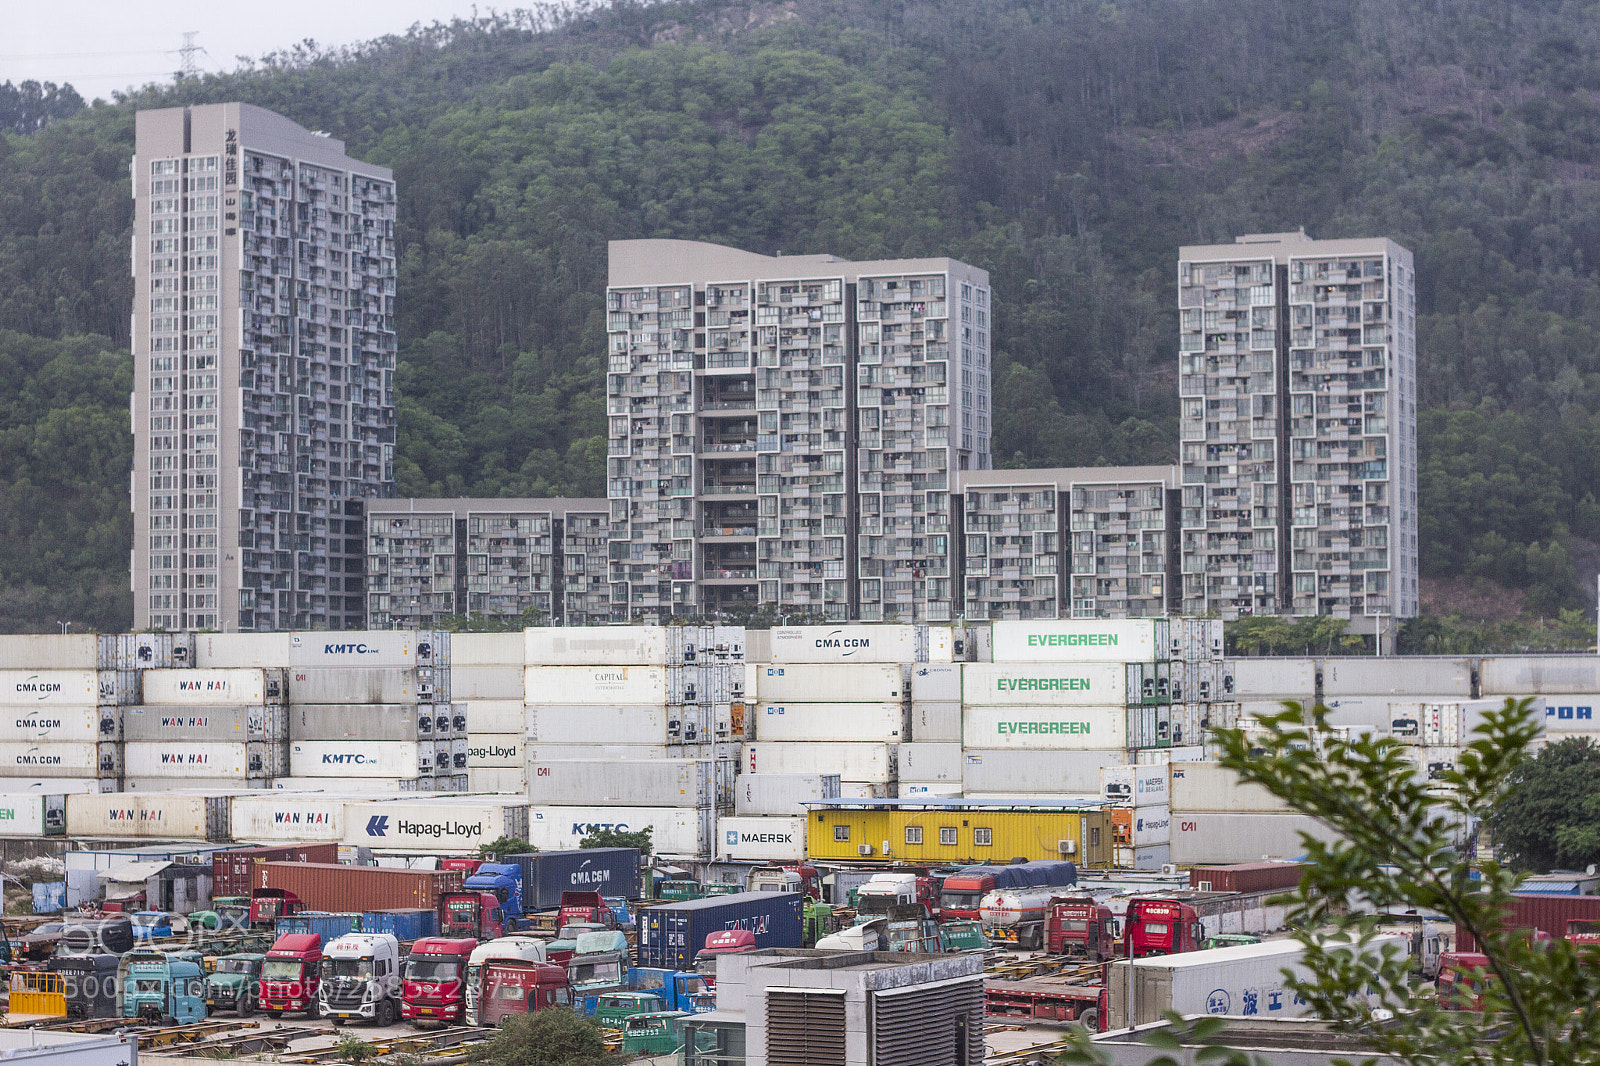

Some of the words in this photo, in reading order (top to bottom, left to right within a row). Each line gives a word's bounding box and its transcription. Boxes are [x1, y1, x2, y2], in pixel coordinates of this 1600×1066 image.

[815, 639, 841, 648] CMA
[843, 638, 870, 648] CGM
[1028, 634, 1119, 647] EVERGREEN
[324, 643, 368, 654] KMTC
[295, 674, 306, 682] CAI
[16, 683, 38, 692] CMA
[39, 683, 61, 692] CGM
[180, 681, 201, 690] WAN
[207, 681, 226, 690] HAI
[997, 678, 1091, 691] EVERGREEN
[16, 719, 38, 728] CMA
[39, 719, 61, 728] CGM
[161, 717, 183, 727] WAN
[188, 717, 208, 727] HAI
[997, 722, 1091, 734] EVERGREEN
[467, 745, 516, 759] pag-Lloyd
[16, 755, 38, 765] CMA
[39, 755, 61, 765] CGM
[161, 753, 184, 764] WAN
[188, 753, 208, 764] HAI
[322, 754, 366, 764] KMTC
[537, 767, 550, 776] CAI
[109, 809, 134, 820] WAN
[140, 809, 162, 820] HAI
[275, 812, 300, 824] WAN
[306, 812, 328, 824] HAI
[398, 820, 482, 838] Hapag-Lloyd
[1181, 821, 1197, 831] CAI
[741, 833, 792, 843] MAERSK
[571, 871, 590, 885] CMA
[591, 869, 610, 883] CGM
